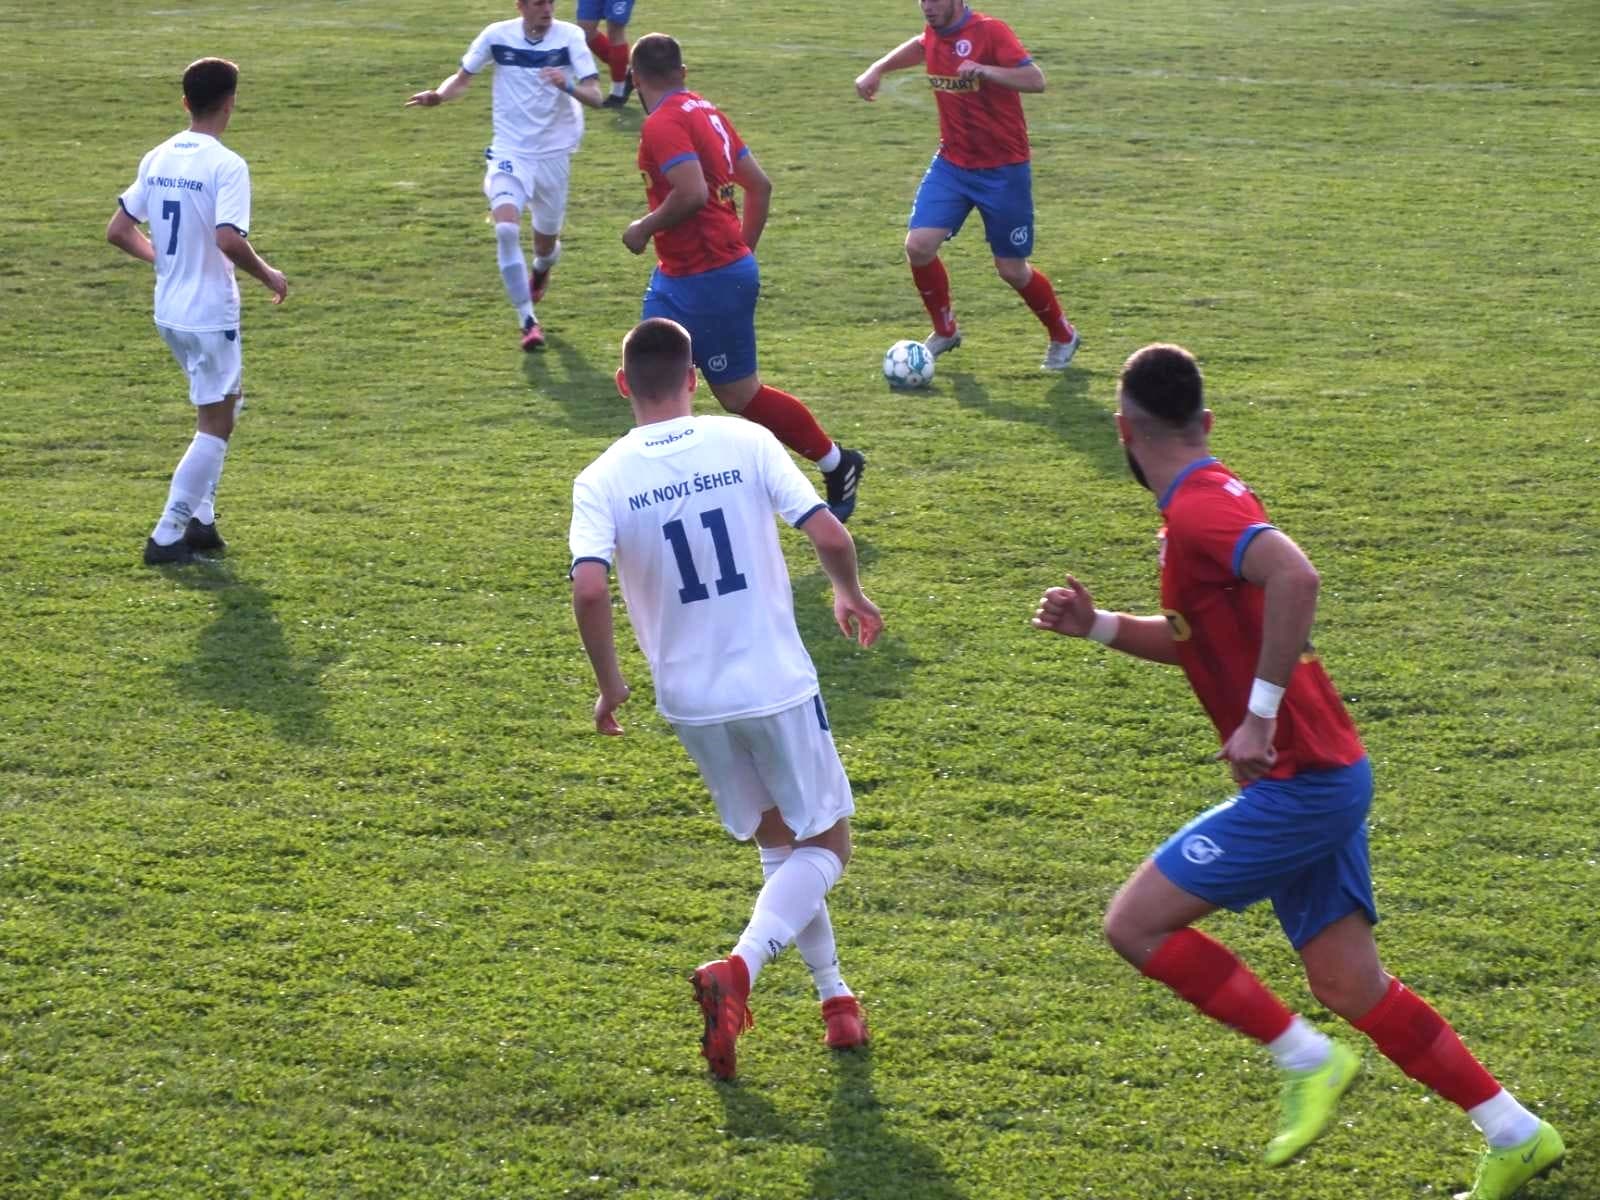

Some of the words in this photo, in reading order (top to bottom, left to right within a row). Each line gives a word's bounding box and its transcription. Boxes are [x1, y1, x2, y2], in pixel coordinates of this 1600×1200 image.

[162, 200, 181, 255] 7
[644, 428, 695, 448] umbro
[628, 491, 652, 511] NK
[652, 480, 691, 503] NOVI
[693, 469, 743, 493] ŠEHER
[662, 507, 748, 605] 11
